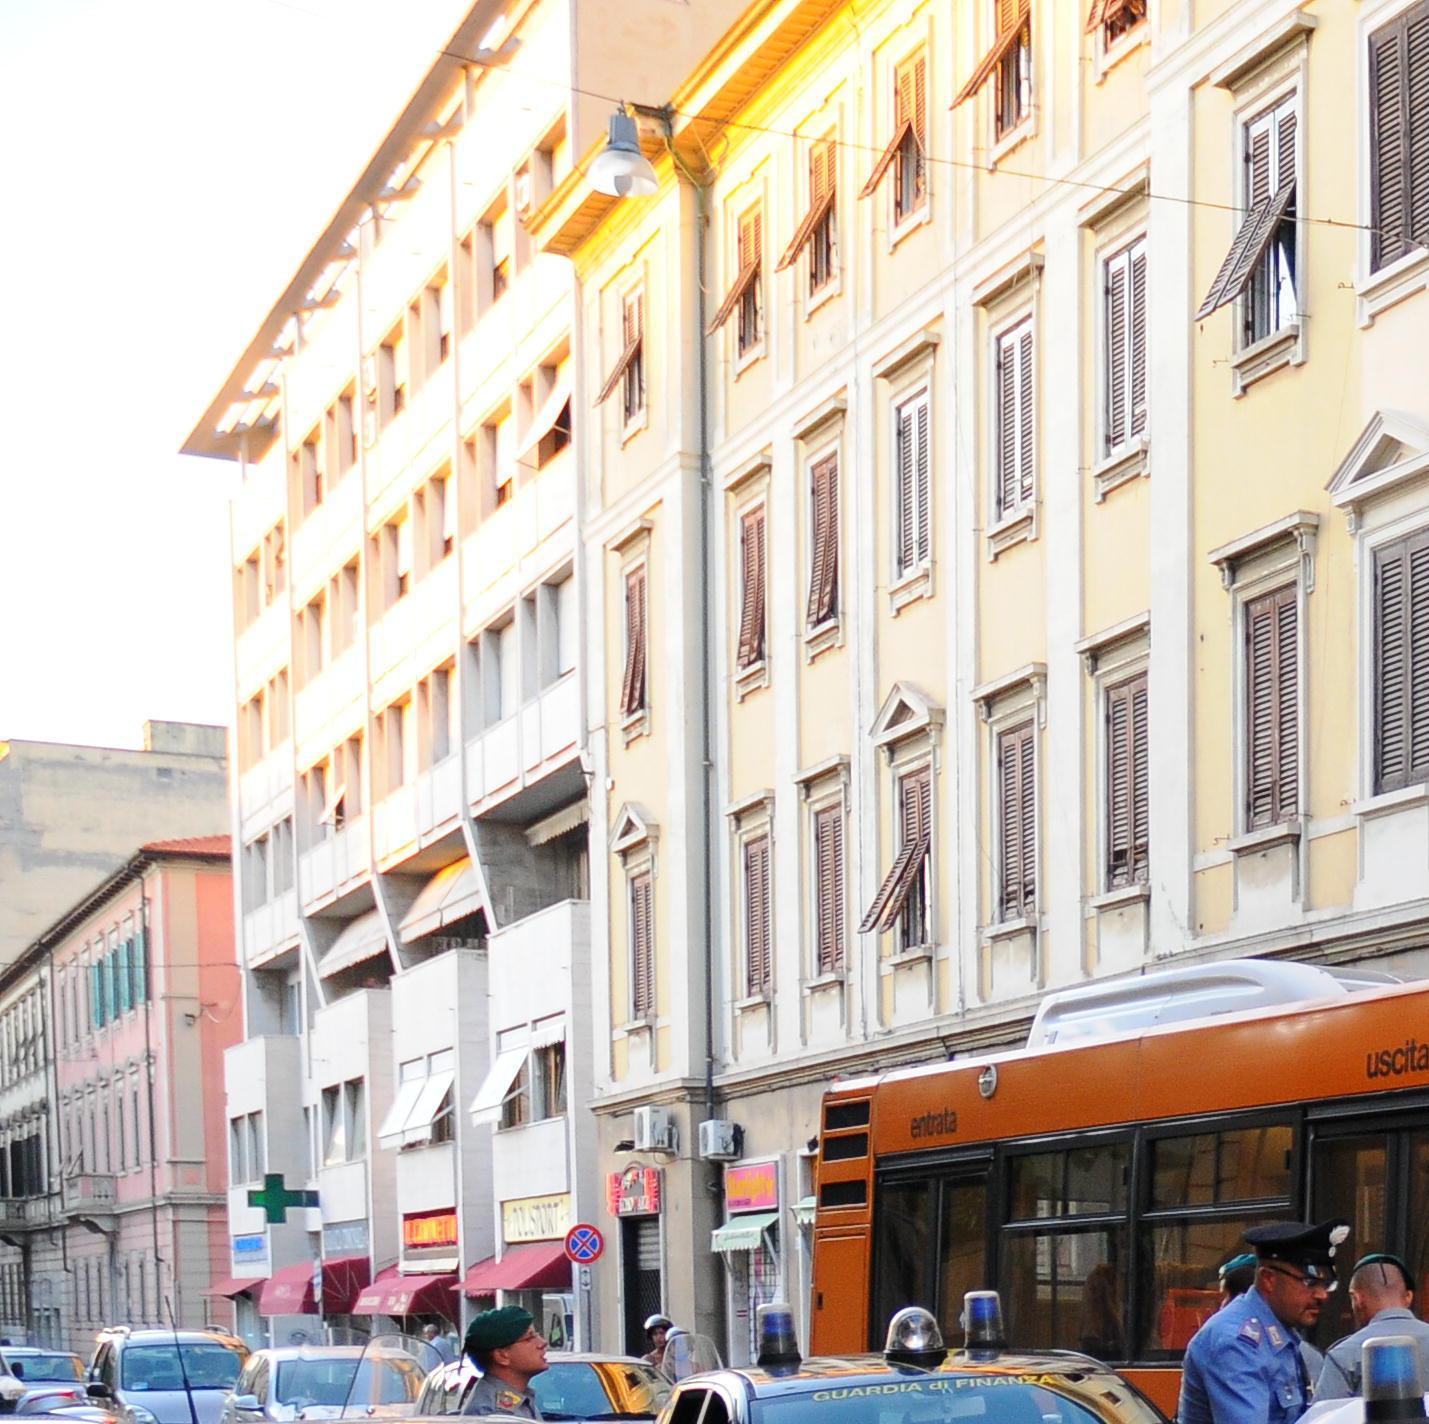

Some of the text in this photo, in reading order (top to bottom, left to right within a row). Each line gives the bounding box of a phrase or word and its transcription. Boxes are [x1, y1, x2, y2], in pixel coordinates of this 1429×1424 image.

[910, 1106, 958, 1139] entrata
[812, 1374, 1057, 1402] GUARDIA di FINANZA
